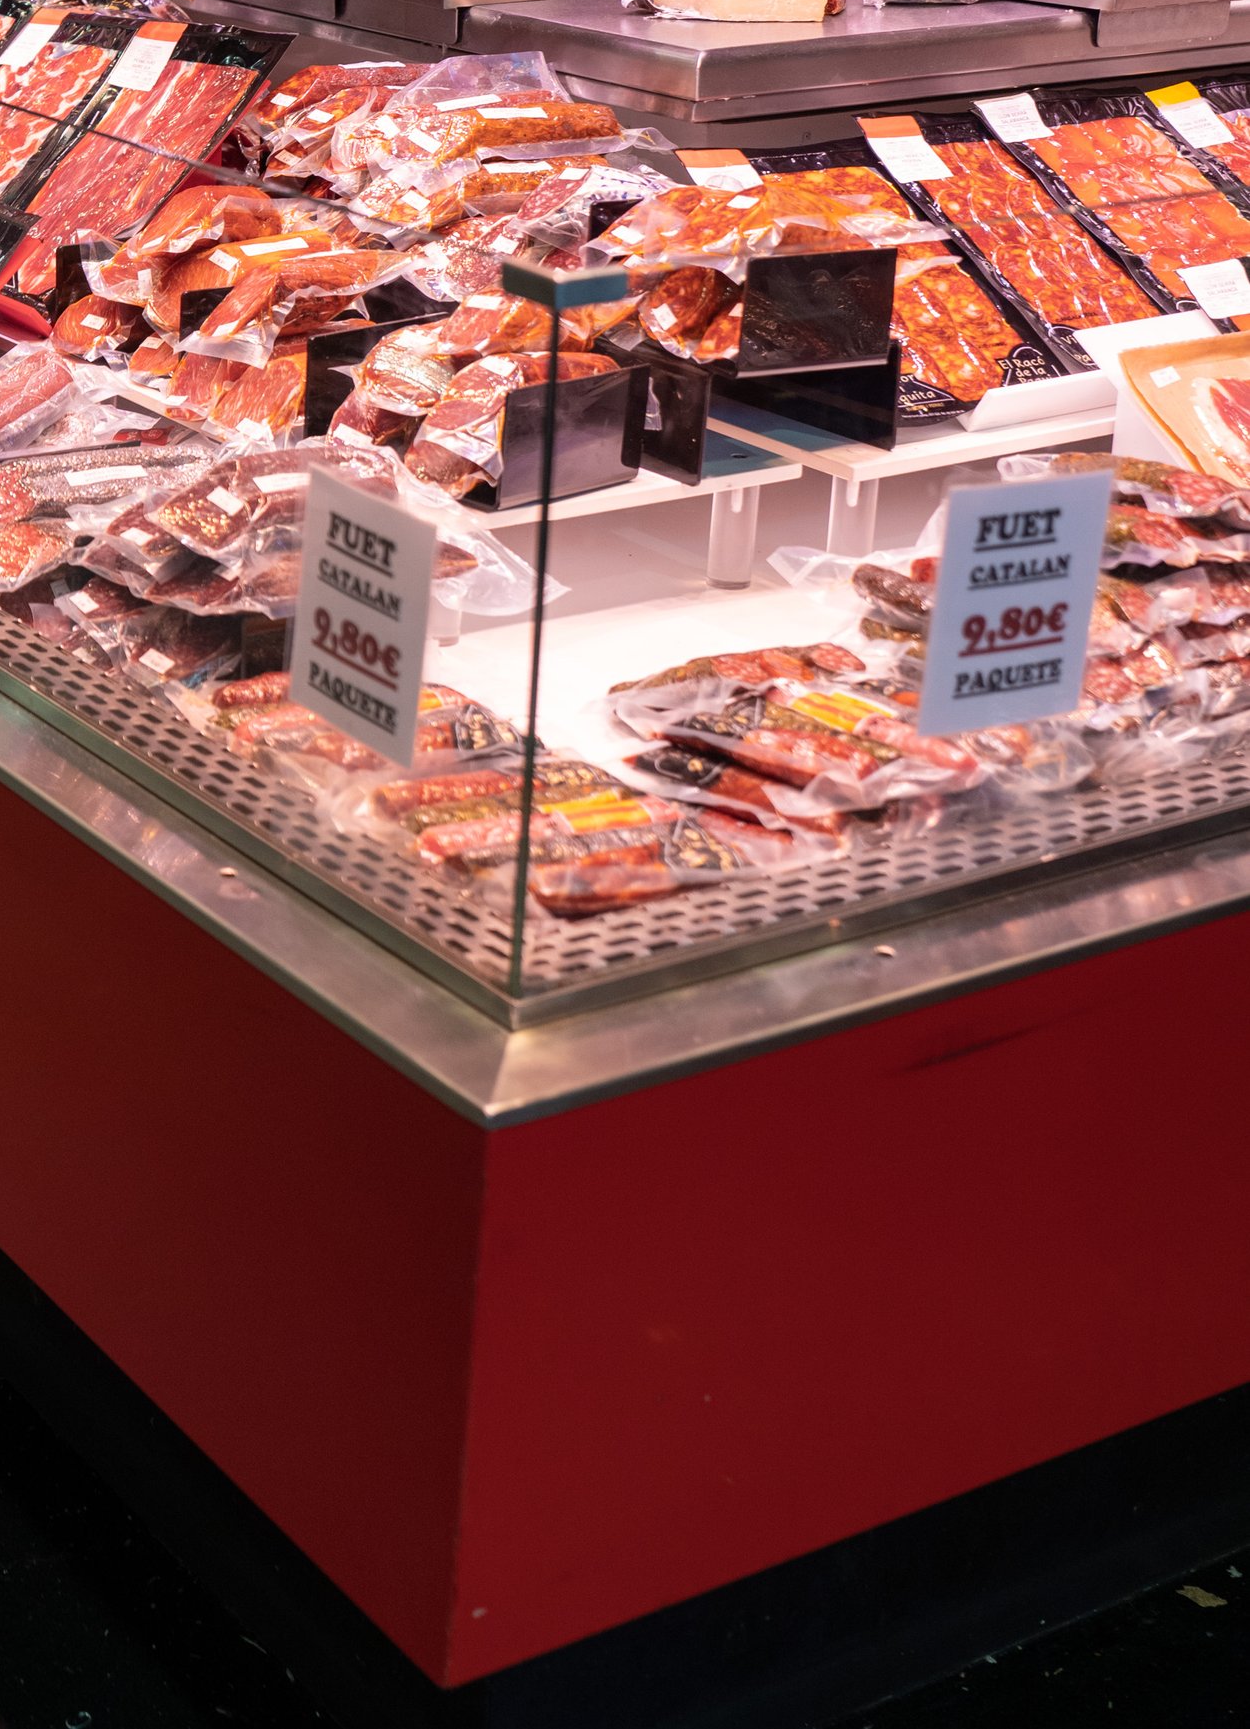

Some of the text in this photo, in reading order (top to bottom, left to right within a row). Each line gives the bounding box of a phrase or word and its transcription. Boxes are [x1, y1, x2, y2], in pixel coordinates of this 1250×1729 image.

[998, 355, 1046, 370] El Racó
[1015, 365, 1047, 377] de la
[899, 391, 936, 406] quita
[328, 511, 396, 568] FUET
[976, 507, 1061, 543] FUET
[318, 558, 401, 615] CATALAN
[969, 554, 1070, 585] CATALAN
[313, 606, 401, 678] 9,80€
[961, 602, 1069, 651] 9,80€
[308, 660, 398, 727] PAQUETE
[954, 658, 1063, 694] PAQUETE
